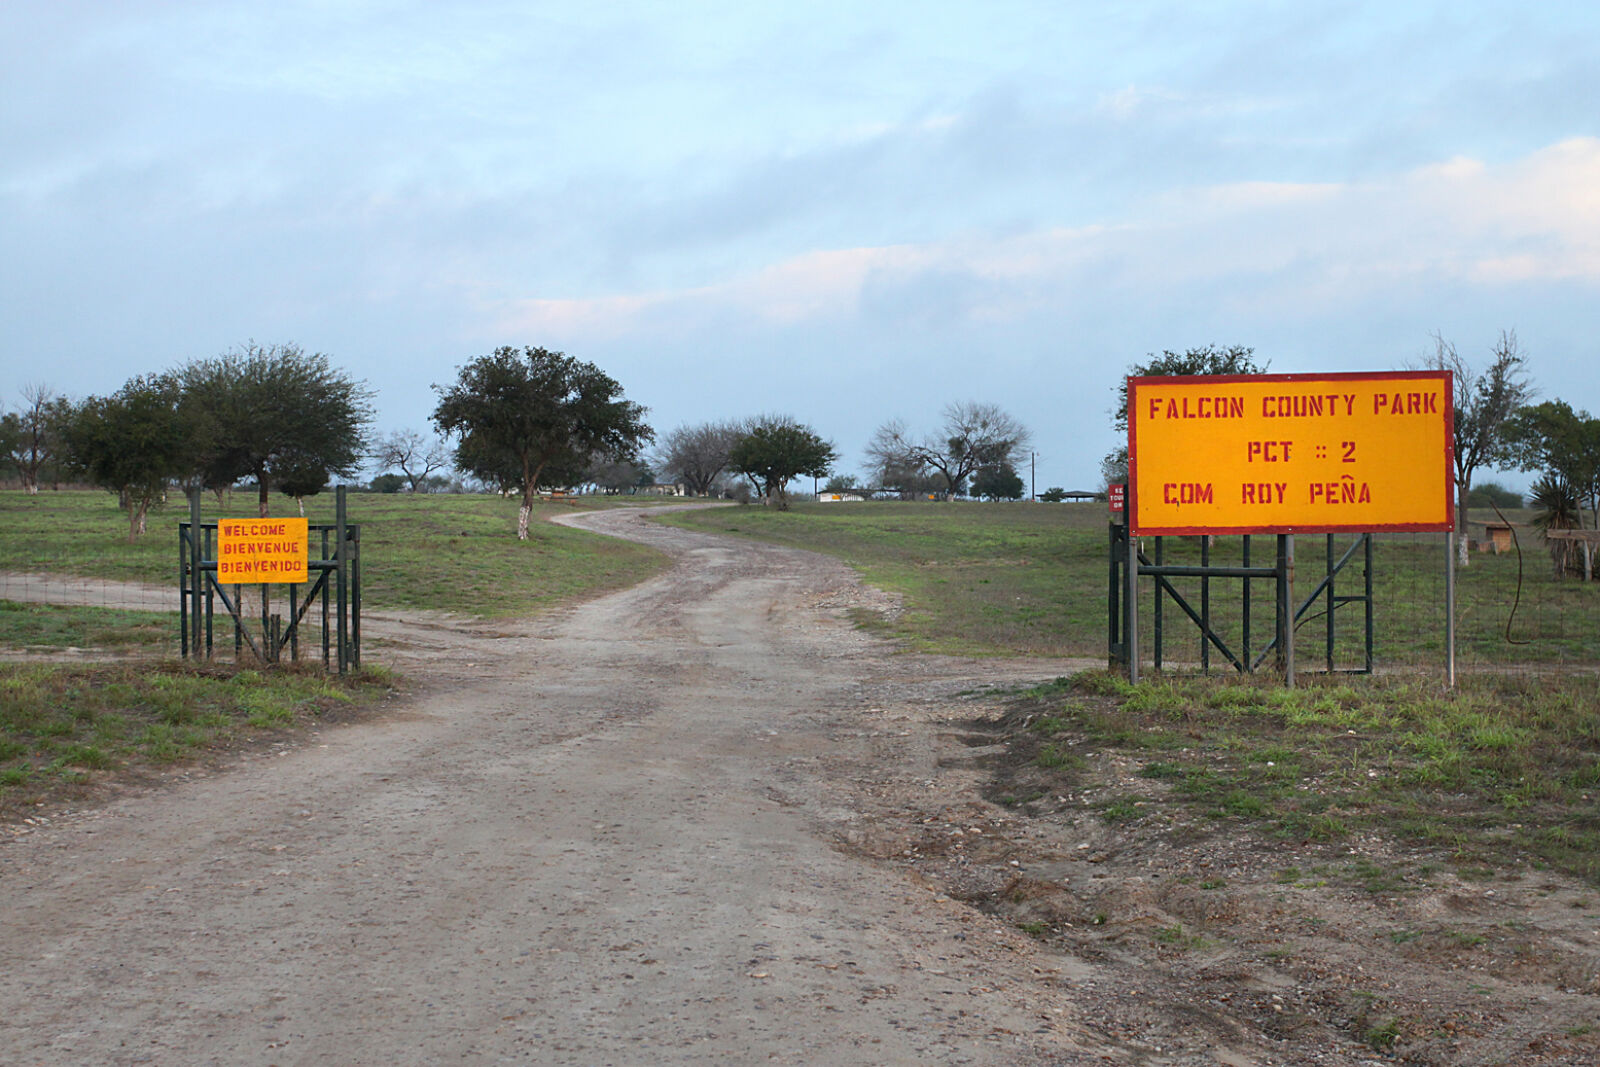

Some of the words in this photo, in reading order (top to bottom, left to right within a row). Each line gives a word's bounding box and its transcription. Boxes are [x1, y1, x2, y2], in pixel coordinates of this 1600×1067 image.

[1149, 397, 1244, 419] FALCON
[1262, 394, 1356, 418] COUNTY
[1373, 392, 1438, 415] PARK
[1248, 441, 1293, 463] PCT
[1341, 441, 1356, 463] 2
[1163, 483, 1214, 504] COM
[1242, 482, 1288, 505] ROY
[1309, 474, 1372, 504] PEÑA
[223, 524, 286, 536] WELCOME
[223, 542, 299, 555] BIENVENUE
[221, 560, 302, 573] BIENVENIDO
